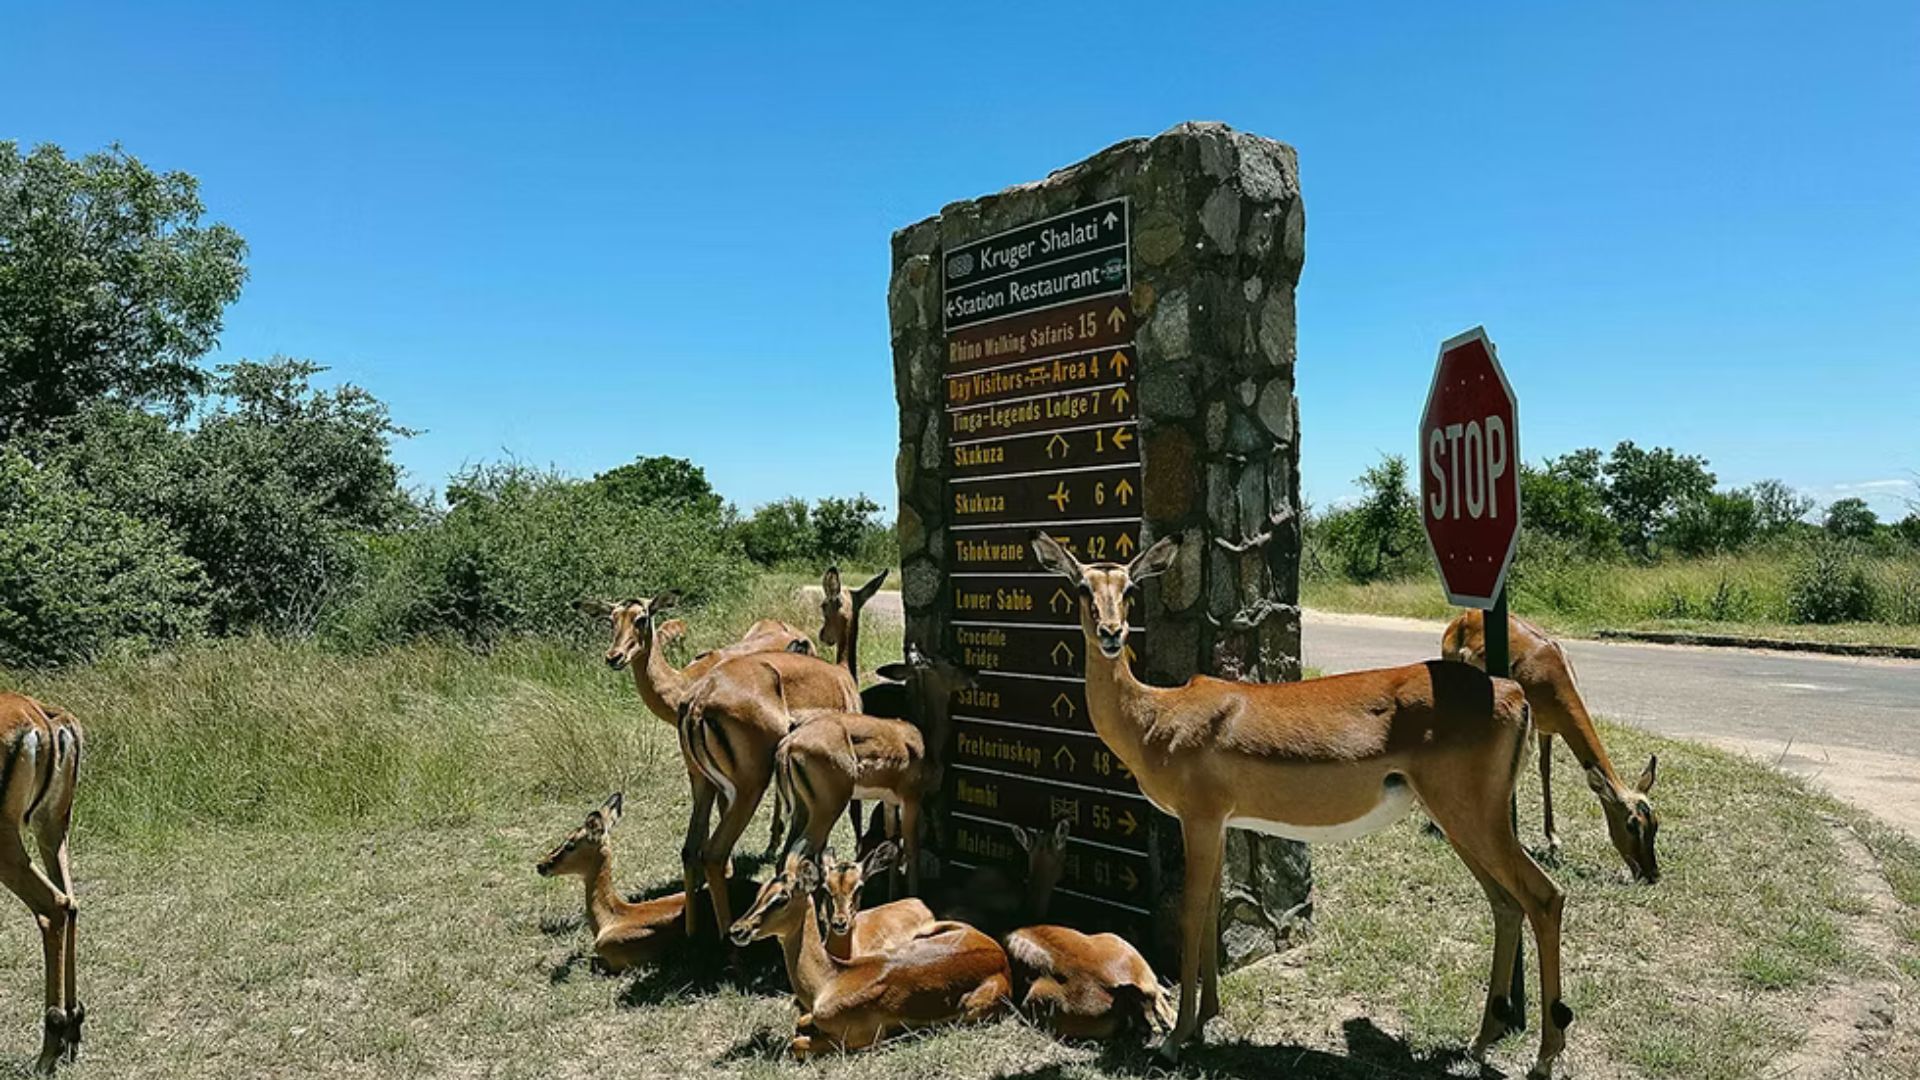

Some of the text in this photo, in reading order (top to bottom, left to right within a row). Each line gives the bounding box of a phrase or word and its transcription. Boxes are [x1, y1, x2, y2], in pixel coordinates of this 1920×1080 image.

[980, 217, 1098, 268] Kruger Shalati
[957, 271, 1100, 317] Station Restaurant
[950, 312, 1097, 363] Rhino Walking Safaris 15
[950, 356, 1098, 400] Day Visitors Area 4
[1046, 392, 1088, 418] Lodge
[1092, 392, 1100, 414] 7
[955, 431, 1103, 466] Skukuza 1
[1429, 415, 1507, 520] STOP
[955, 482, 1104, 514] Skukuza 6
[956, 535, 1106, 562] Tshokwane 42
[956, 588, 1033, 611] Lower Sabie
[957, 627, 1006, 647] Crocodile
[964, 648, 999, 668] Bridge
[957, 687, 1000, 709] Satara
[958, 732, 1110, 776] Pretoriuskop 48
[1092, 804, 1110, 830] 55
